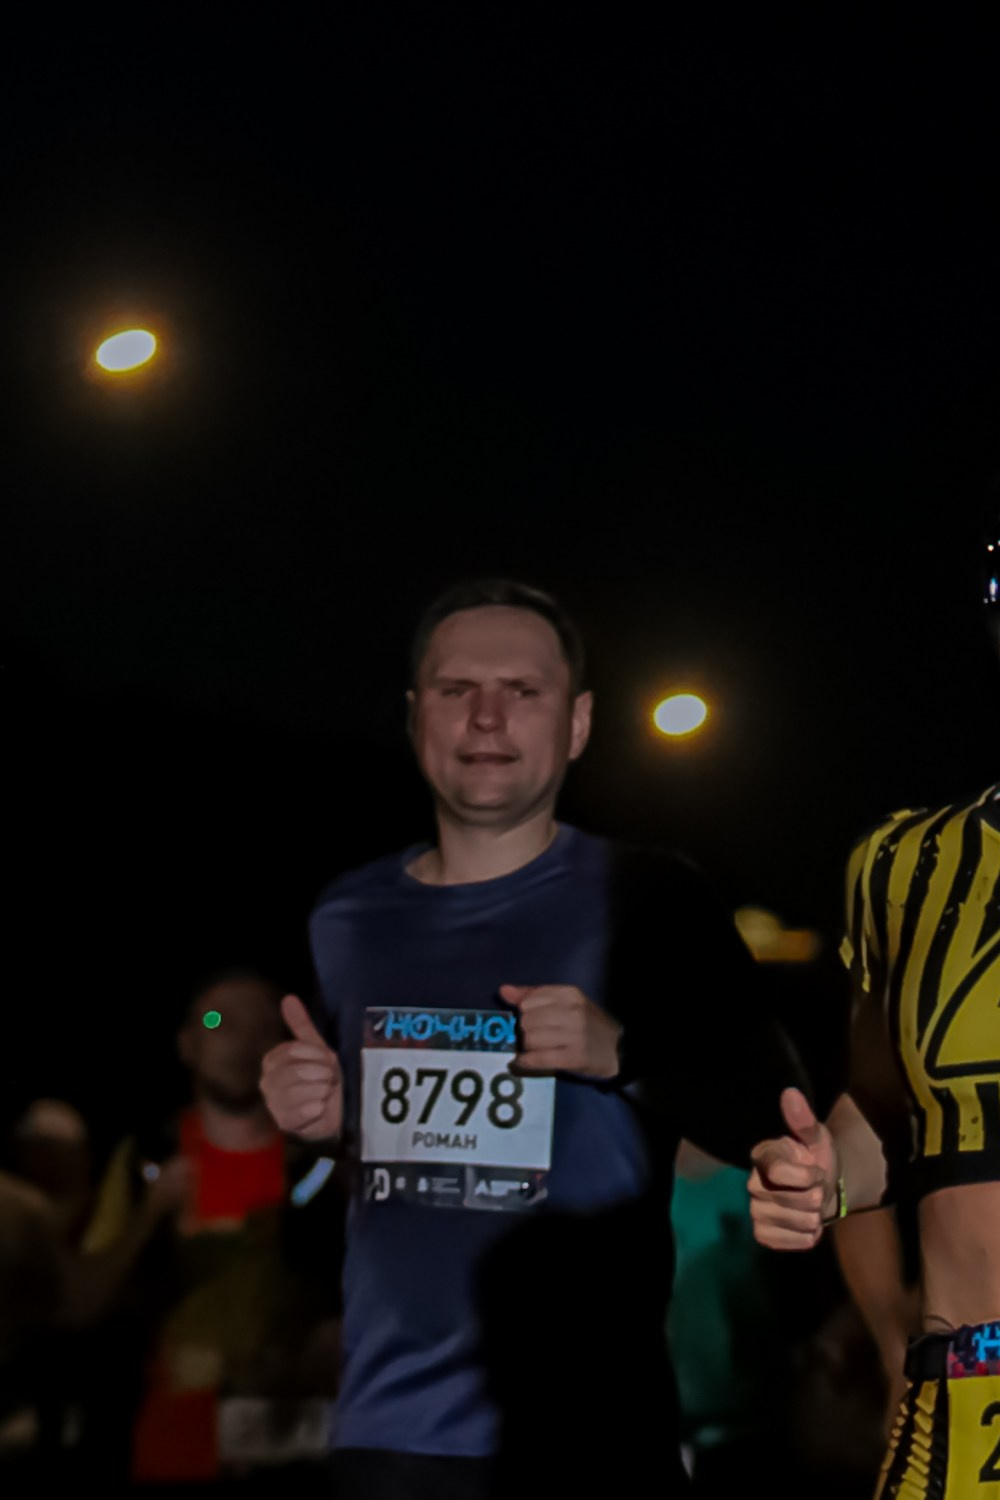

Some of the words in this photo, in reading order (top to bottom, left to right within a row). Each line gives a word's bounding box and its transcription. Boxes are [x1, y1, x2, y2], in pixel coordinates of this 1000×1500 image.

[384, 1011, 519, 1044] НОЧНО
[381, 1066, 524, 1130] 8798
[412, 1131, 477, 1150] РОМАН
